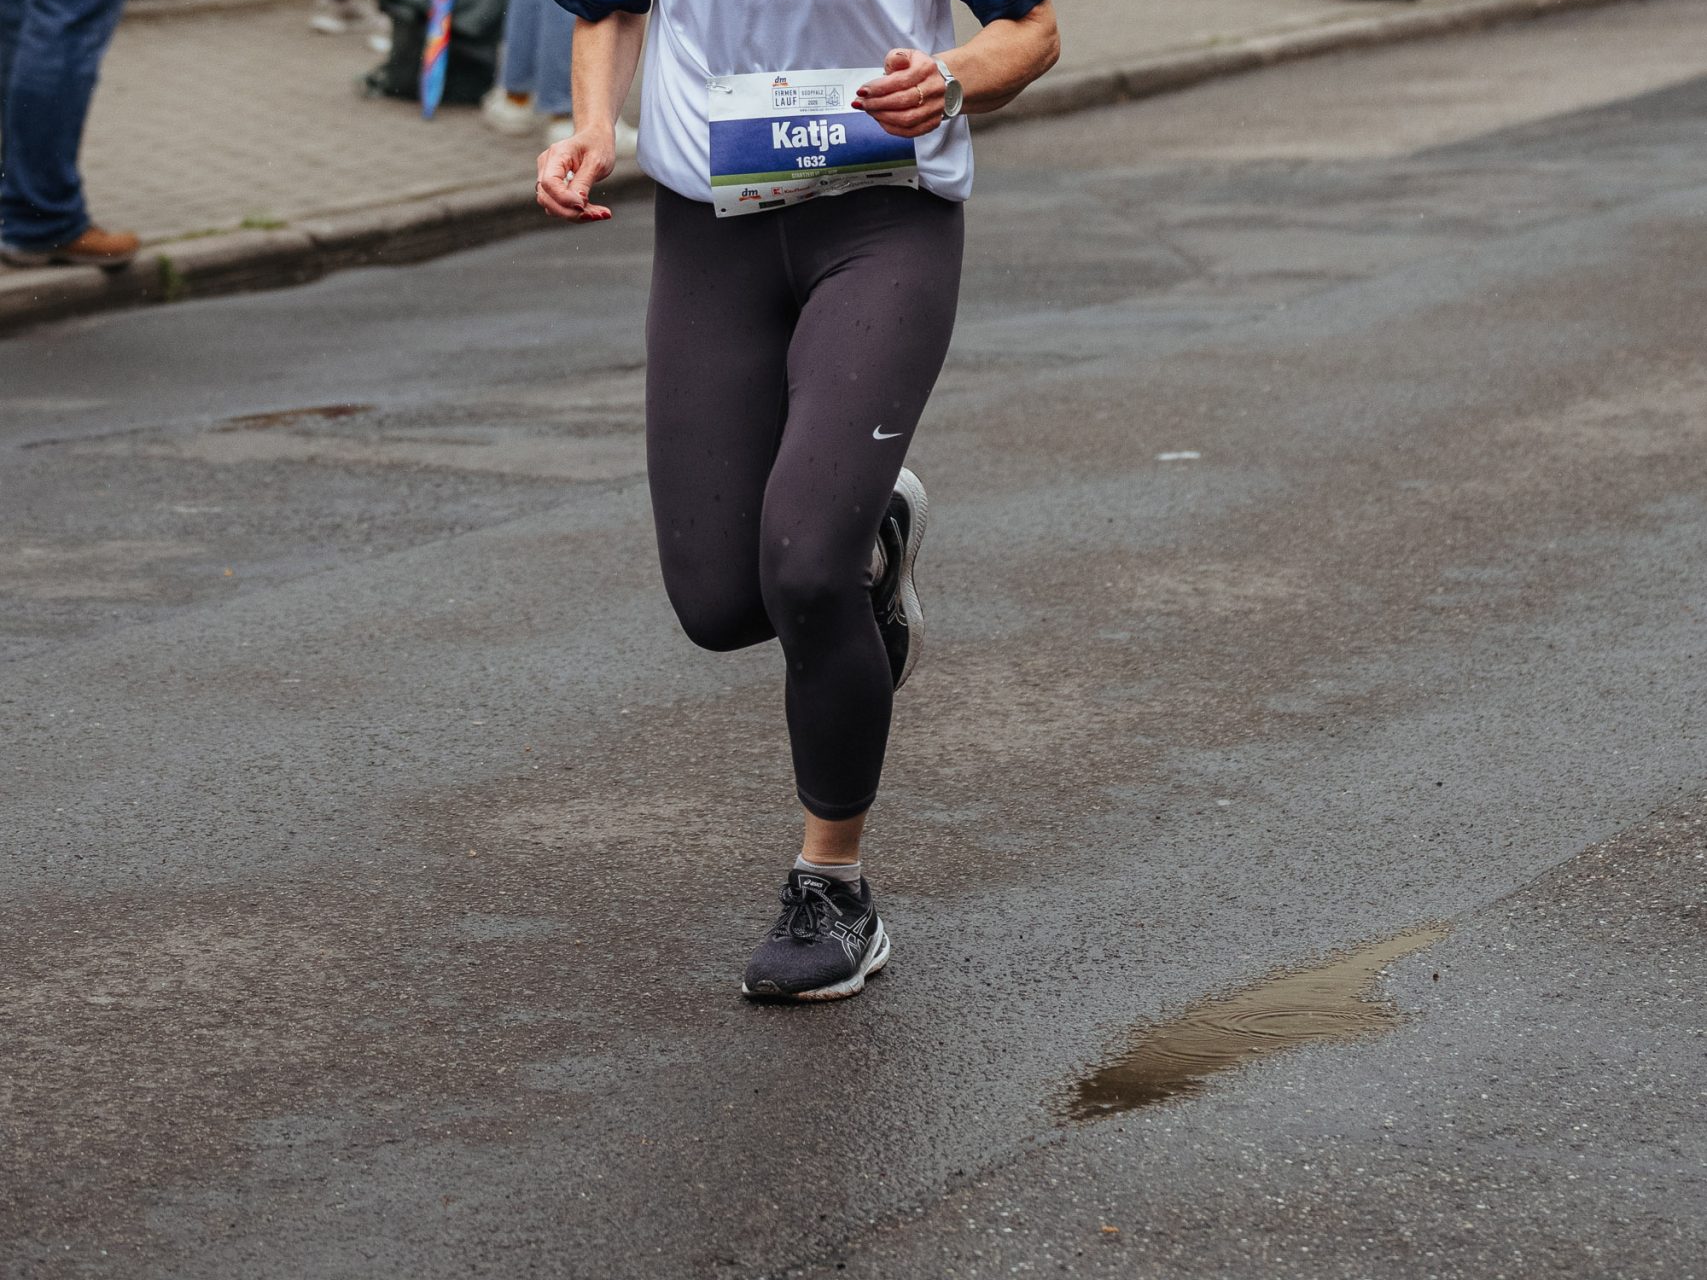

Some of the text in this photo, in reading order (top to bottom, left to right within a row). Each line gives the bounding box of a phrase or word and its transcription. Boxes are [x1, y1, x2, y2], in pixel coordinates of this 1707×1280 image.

[774, 75, 787, 84] dm
[774, 89, 797, 97] FIRMEN
[775, 96, 797, 107] LAUF
[771, 119, 847, 152] Katja
[795, 155, 827, 168] 1632
[741, 187, 759, 197] dm
